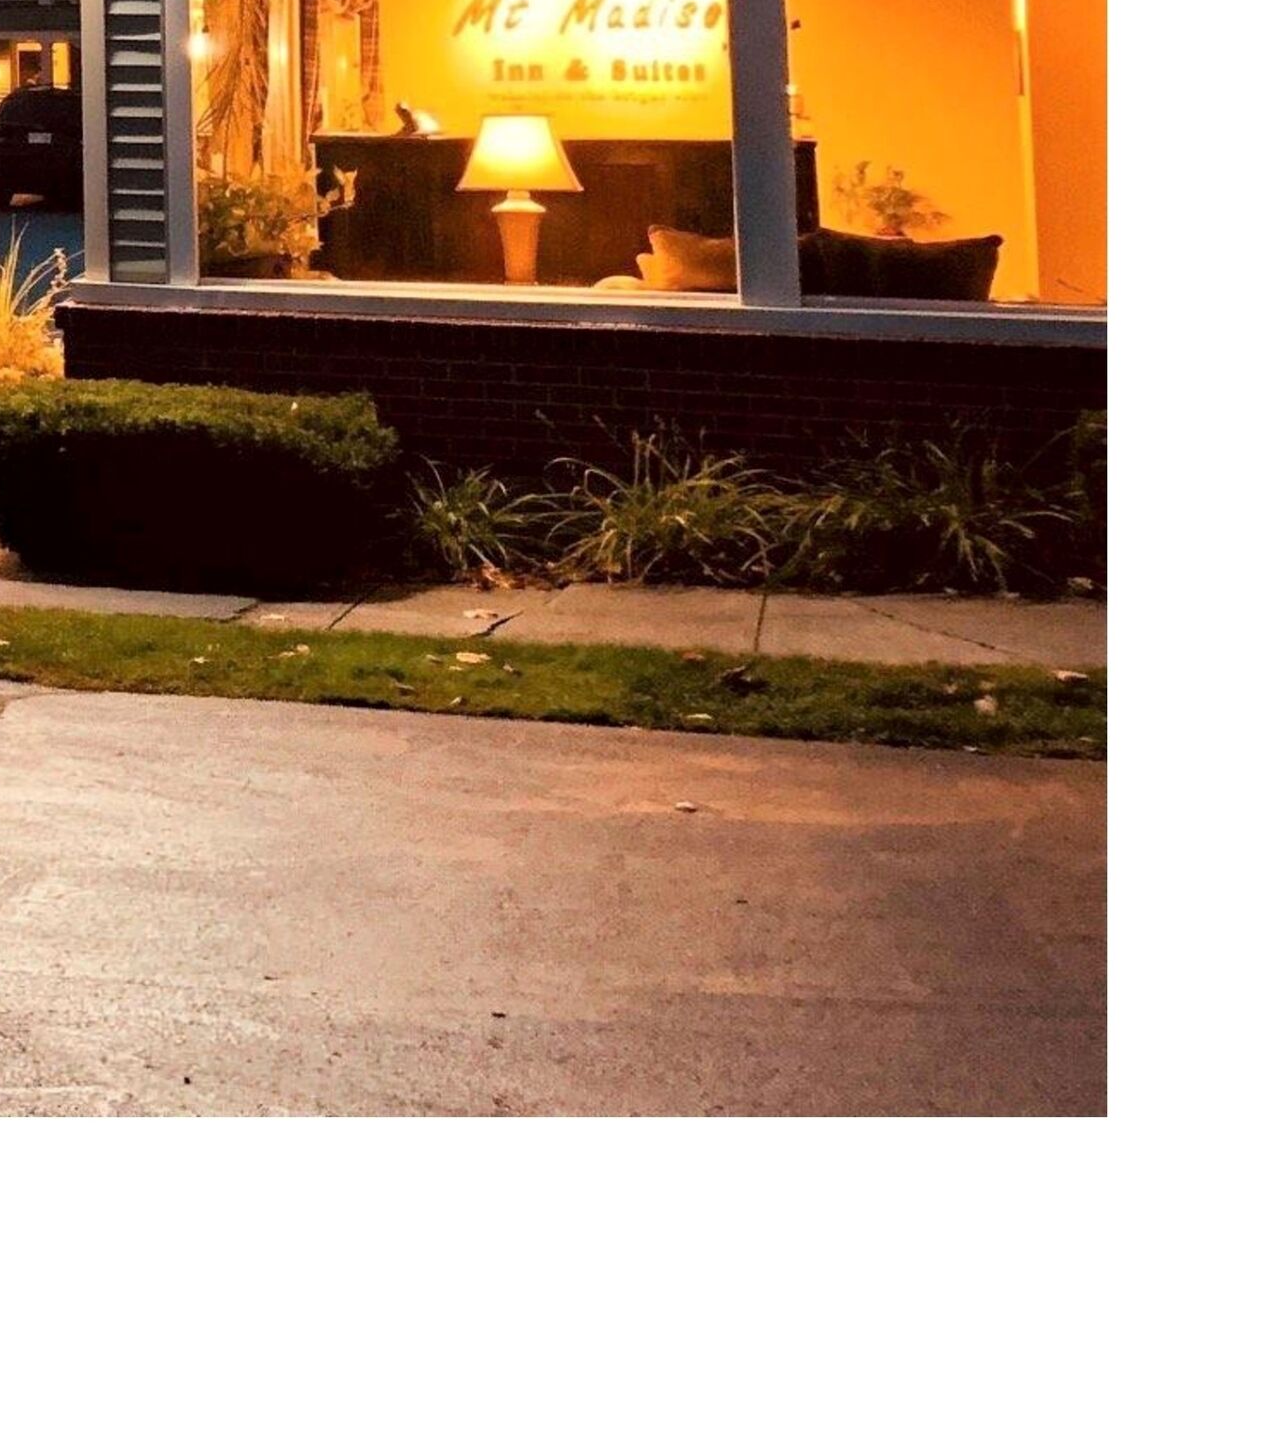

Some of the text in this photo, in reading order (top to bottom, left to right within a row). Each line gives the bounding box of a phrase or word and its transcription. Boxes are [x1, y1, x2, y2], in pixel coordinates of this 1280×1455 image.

[493, 58, 706, 82] Inn & Suites
